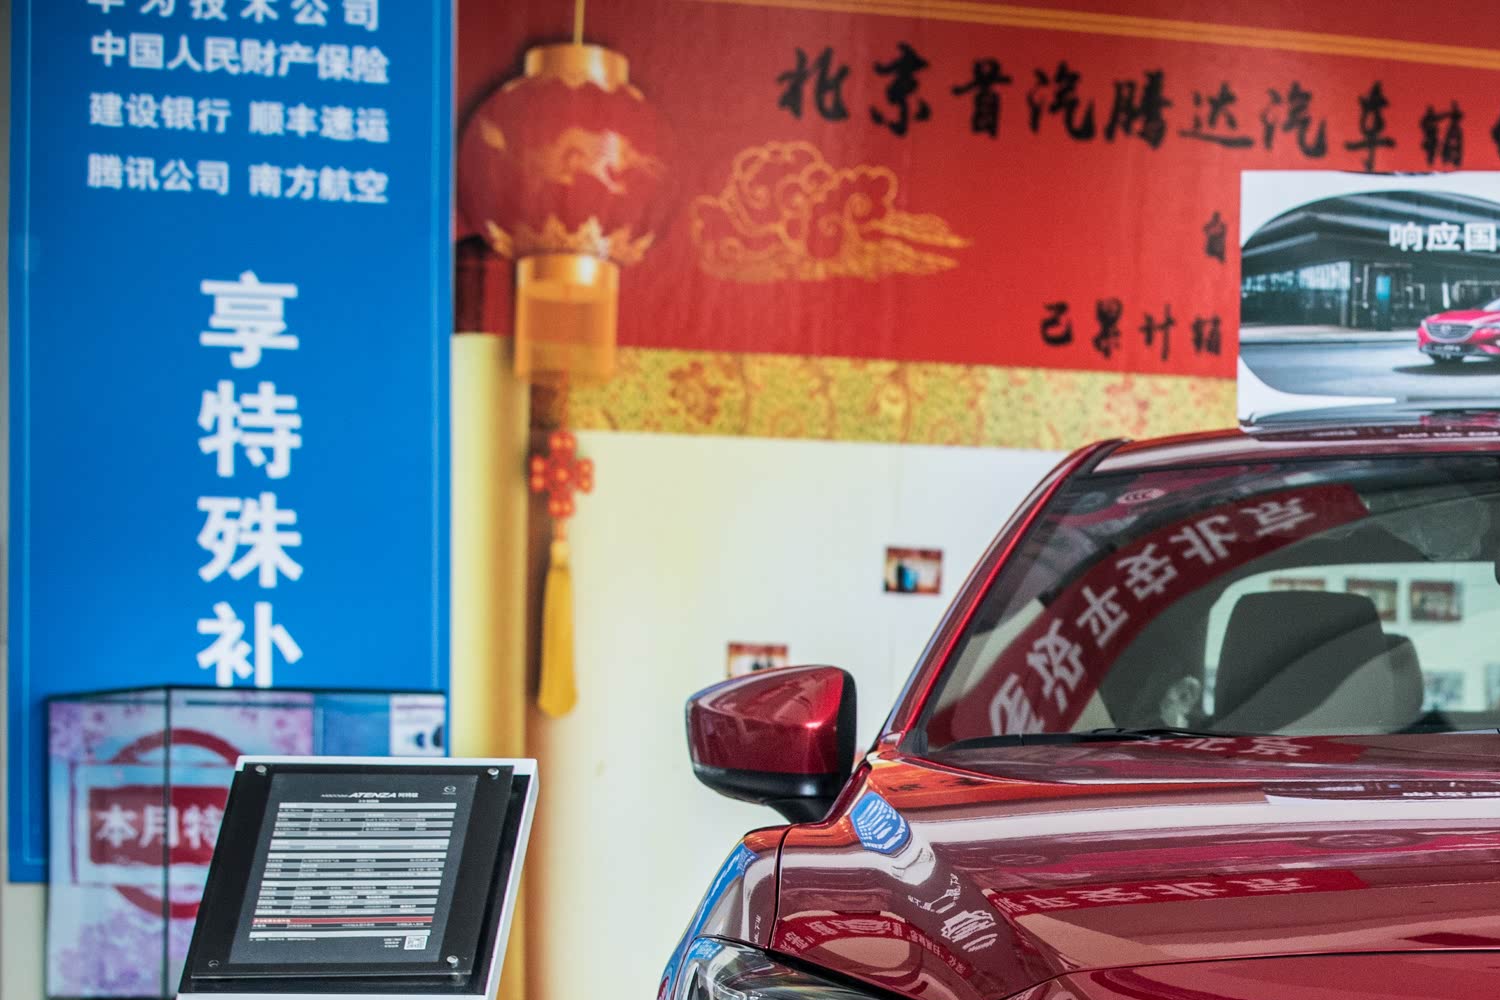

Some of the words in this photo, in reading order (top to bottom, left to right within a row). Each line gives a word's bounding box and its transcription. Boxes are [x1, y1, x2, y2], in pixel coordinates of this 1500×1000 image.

[91, 29, 390, 84] 中国人民财产保险
[89, 93, 231, 133] 建设银行
[249, 101, 390, 143] 顺丰速运
[87, 154, 229, 195] 腾讯公司
[248, 163, 389, 203] 南方航空
[197, 270, 303, 688] 享特殊补
[95, 804, 225, 849] 本月特
